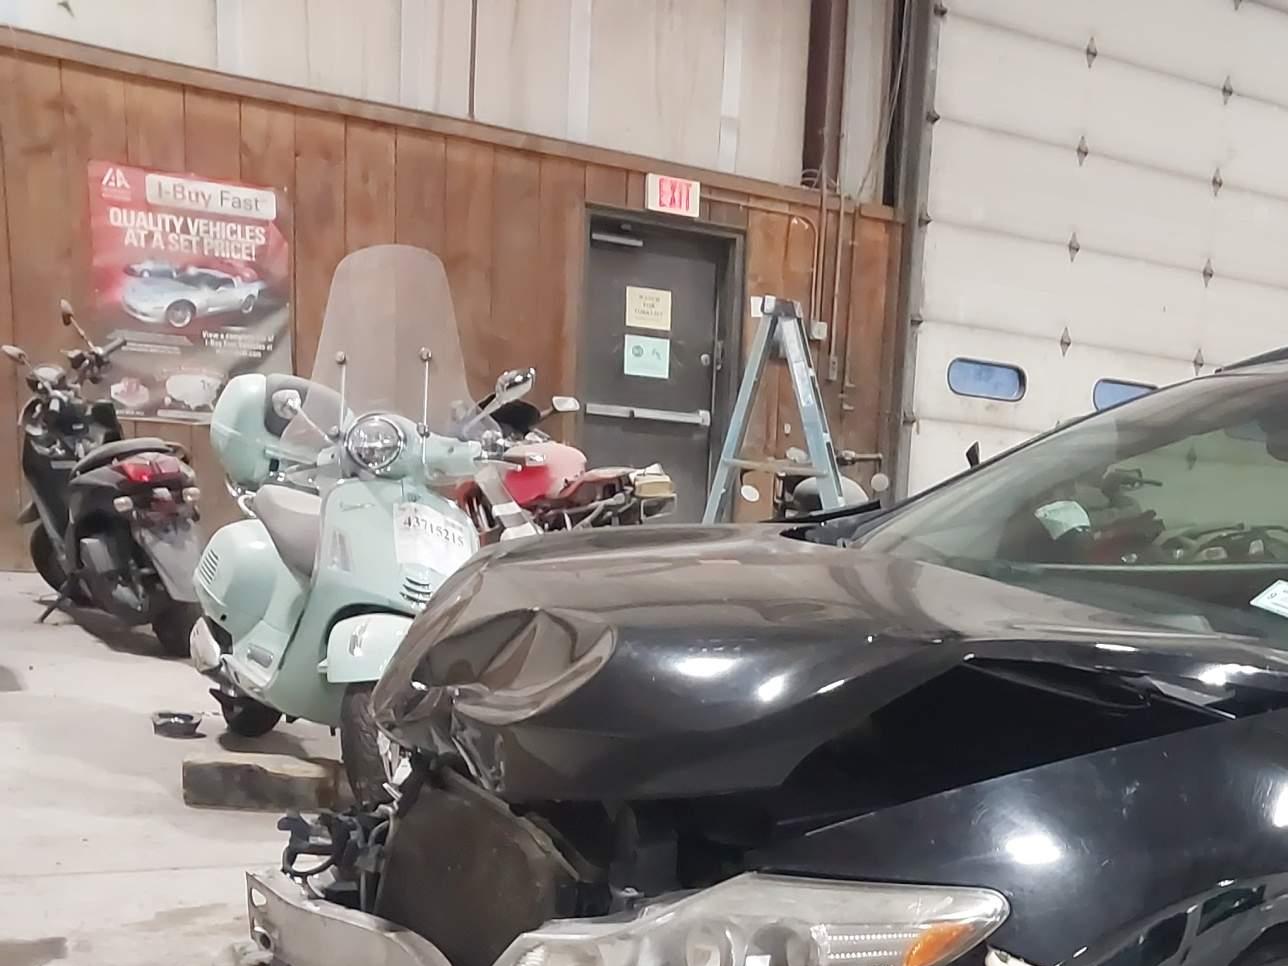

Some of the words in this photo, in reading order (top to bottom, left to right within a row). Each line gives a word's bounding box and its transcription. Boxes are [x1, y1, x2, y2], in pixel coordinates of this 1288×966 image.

[157, 182, 212, 208] I-Buy
[219, 190, 261, 212] Fast
[659, 177, 692, 211] EXIT
[109, 207, 184, 234] QUALITY
[187, 217, 267, 245] VEHICLES
[124, 229, 149, 248] AT
[151, 231, 165, 250] A
[168, 233, 202, 255] SET
[202, 237, 257, 262] PRICE!
[403, 516, 464, 546] 43715215
